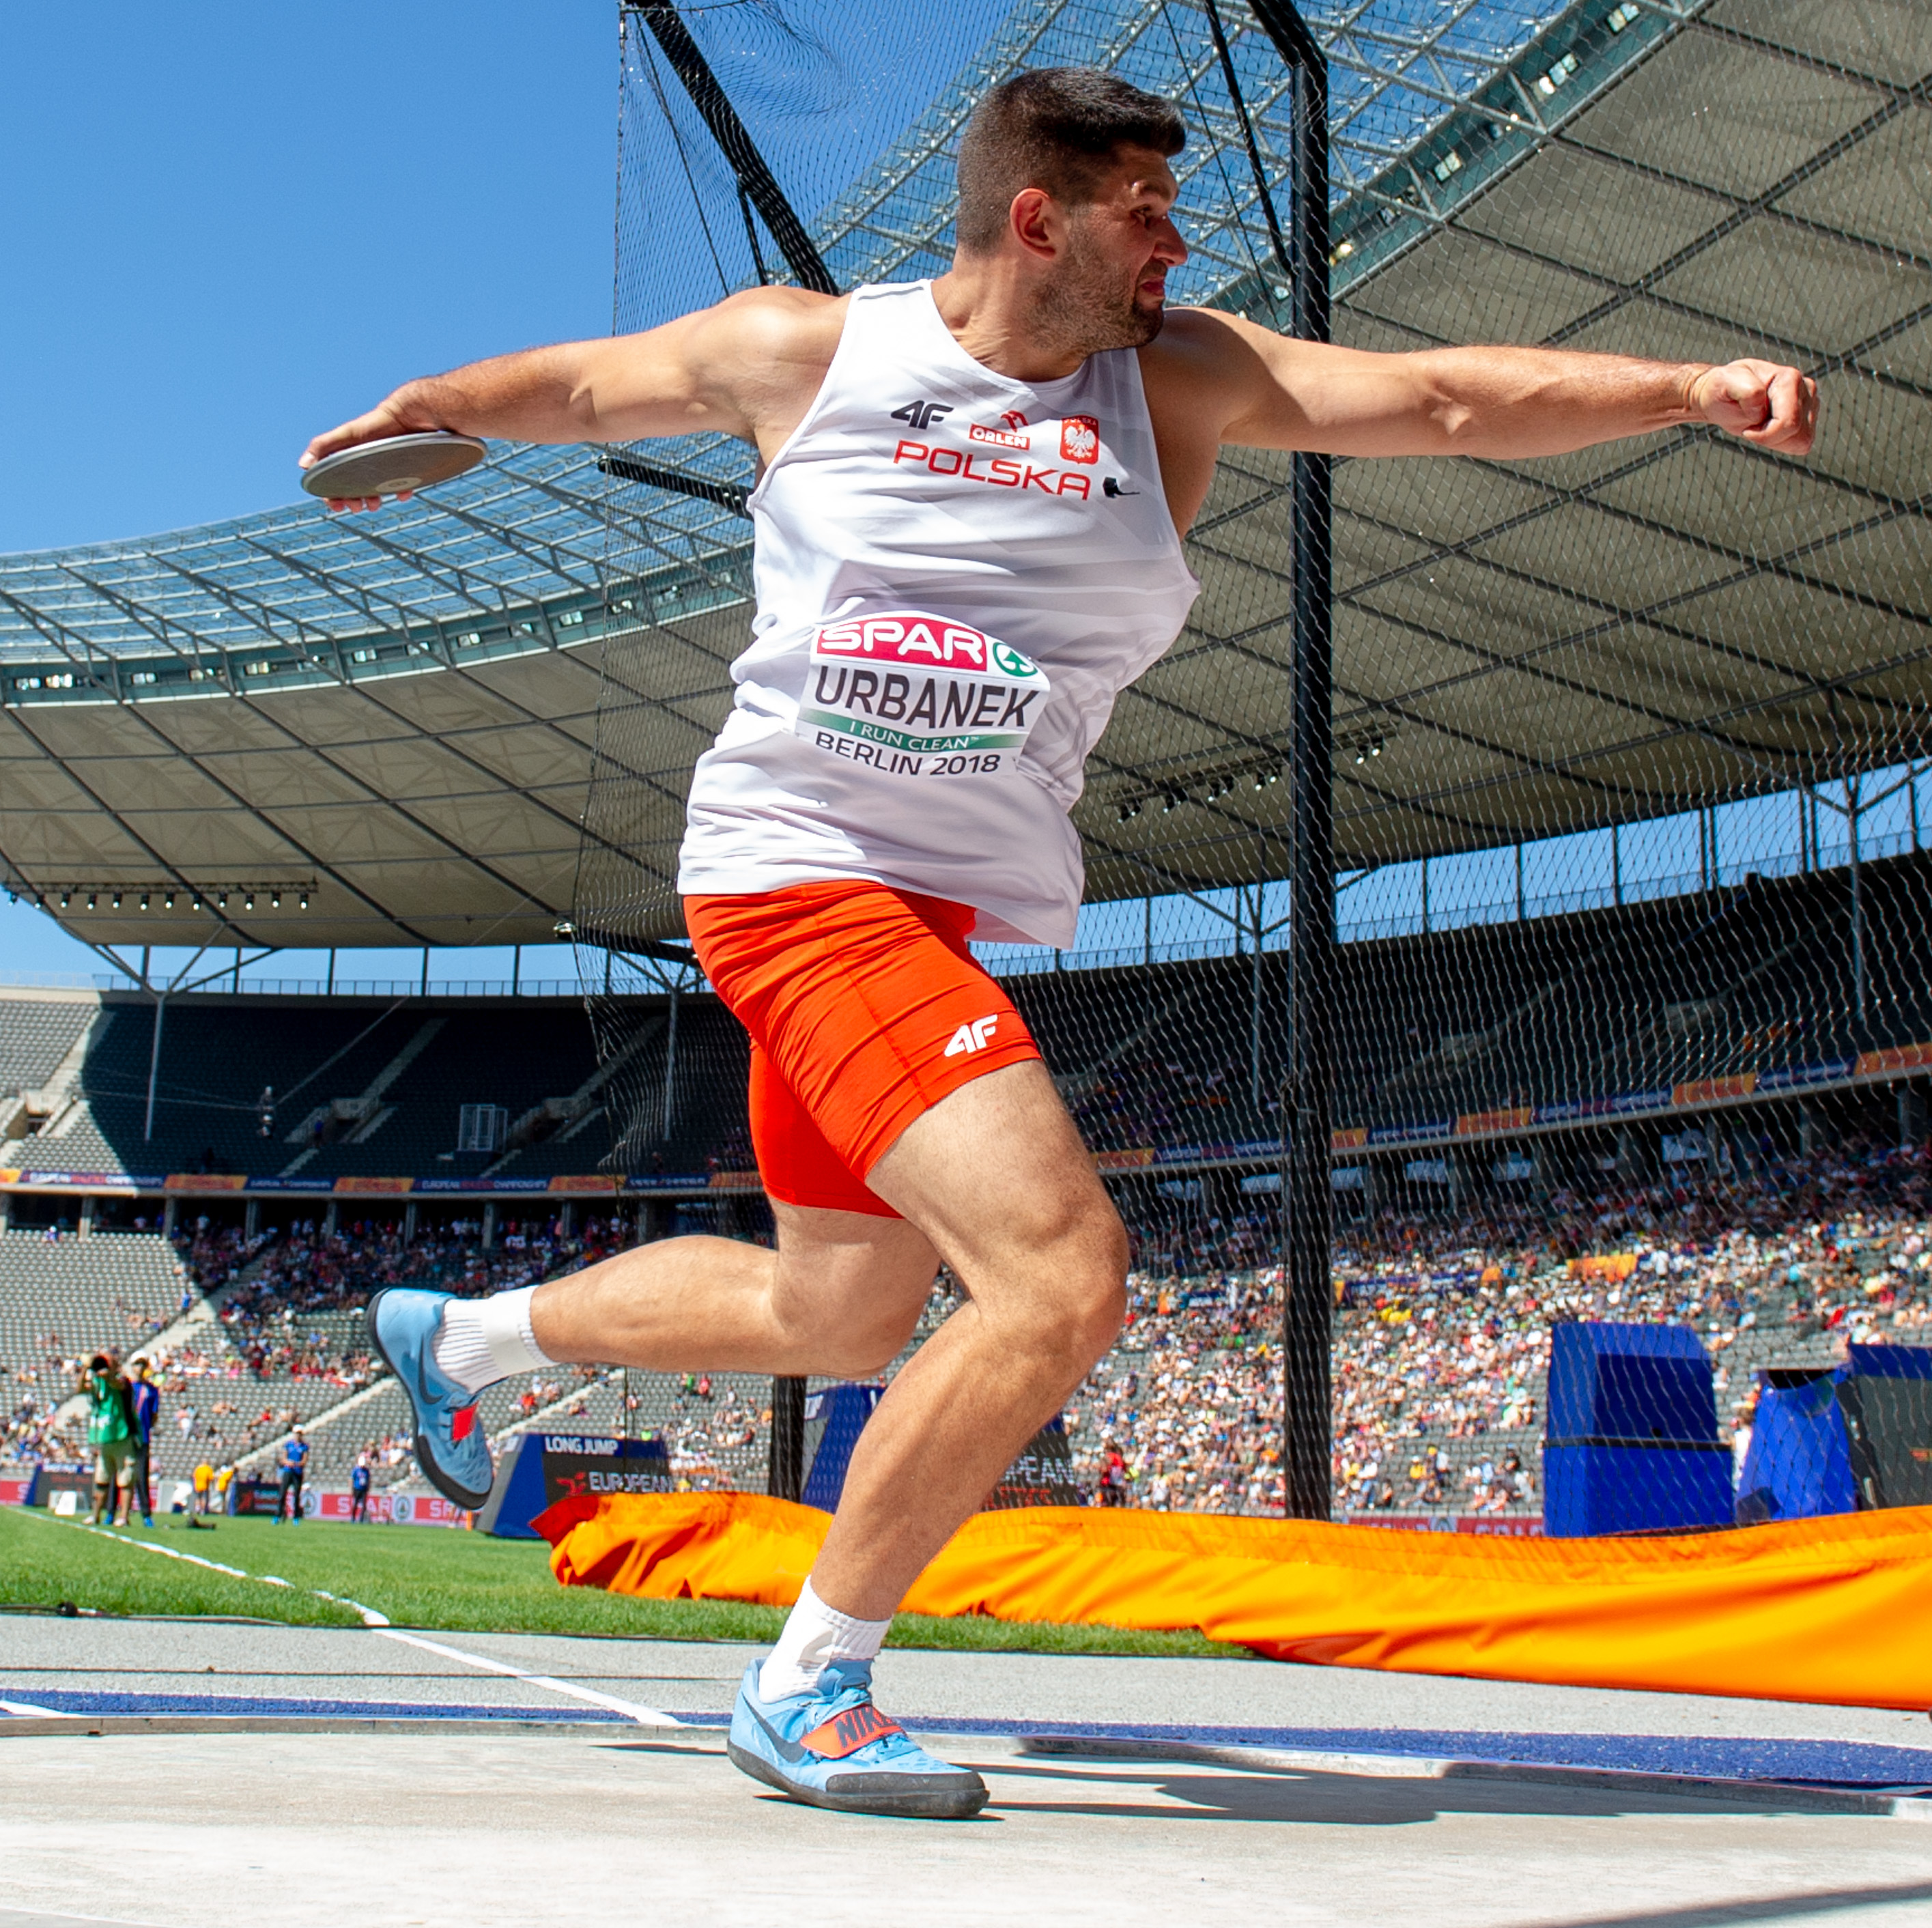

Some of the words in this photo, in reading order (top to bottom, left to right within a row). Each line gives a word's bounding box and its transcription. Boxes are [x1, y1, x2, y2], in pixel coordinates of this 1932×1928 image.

[890, 400, 954, 429] 4F
[972, 427, 1027, 448] ORLEN
[894, 440, 1091, 500] POLSKA
[821, 621, 983, 664] SPAR
[815, 666, 1040, 728] URBANEK
[850, 722, 857, 733] I
[860, 724, 903, 747] RUN
[816, 731, 922, 776] BERLIN
[930, 754, 1001, 776] 2018
[944, 1014, 998, 1057] 4F
[545, 1436, 581, 1454] LONG
[584, 1438, 619, 1455] JUMP
[589, 1472, 673, 1493] EUROPEAN
